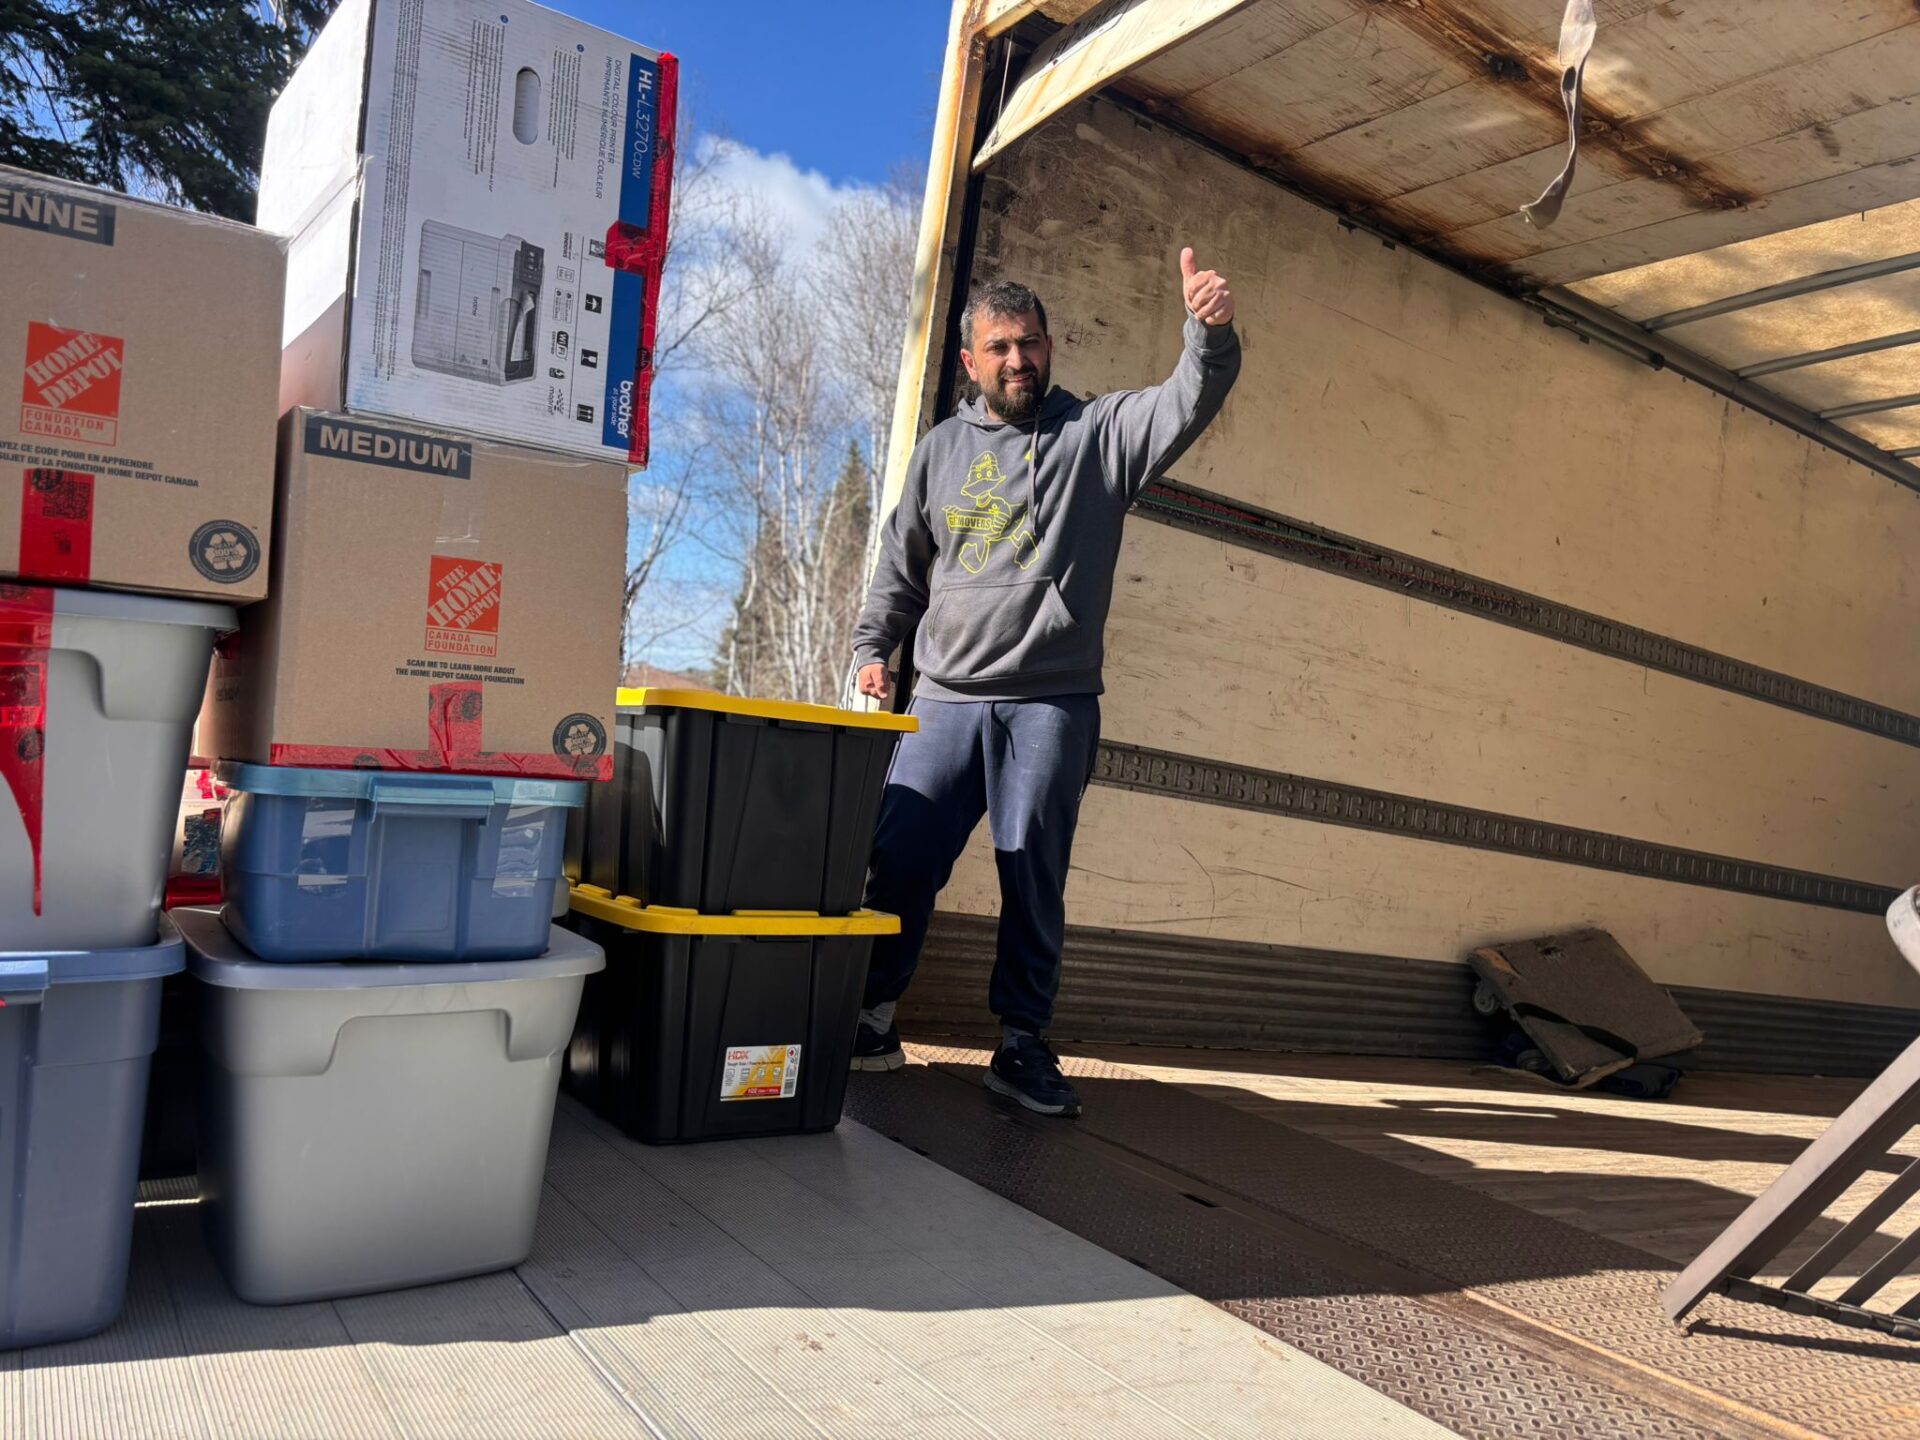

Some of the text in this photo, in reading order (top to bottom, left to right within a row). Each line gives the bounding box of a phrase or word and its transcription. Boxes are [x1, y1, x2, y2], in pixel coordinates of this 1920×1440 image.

[602, 56, 612, 106] IMPRIMANTE
[608, 60, 622, 164] DIGITAL COLOUR PRINTER
[596, 159, 604, 199] COULEUR
[26, 333, 102, 386] HOME
[39, 347, 122, 409] DEPOT
[26, 409, 104, 431] FONDATION
[617, 380, 634, 438] brother
[25, 420, 81, 438] CANADA
[21, 443, 33, 452] CE
[35, 446, 59, 457] CODE
[61, 449, 85, 460] POUR
[88, 453, 99, 462] EN
[101, 455, 154, 470] APPRENDRE
[319, 425, 458, 470] MEDIUM
[28, 455, 40, 464] DE
[42, 458, 54, 466] LA
[56, 459, 105, 474] FONDATION
[107, 466, 133, 478] HOME
[135, 471, 163, 482] DEPOT
[165, 475, 199, 487] CANADA
[428, 563, 501, 626] HOME
[436, 564, 468, 592] THE
[455, 588, 500, 629] DEPOT
[427, 640, 494, 654] FOUNDATION
[428, 630, 471, 643] CANADA
[395, 668, 525, 685] THE HOME DEPOT CANADA FOUNDATION
[406, 659, 516, 675] SCAN ME TO LEARN MORE ABOUT
